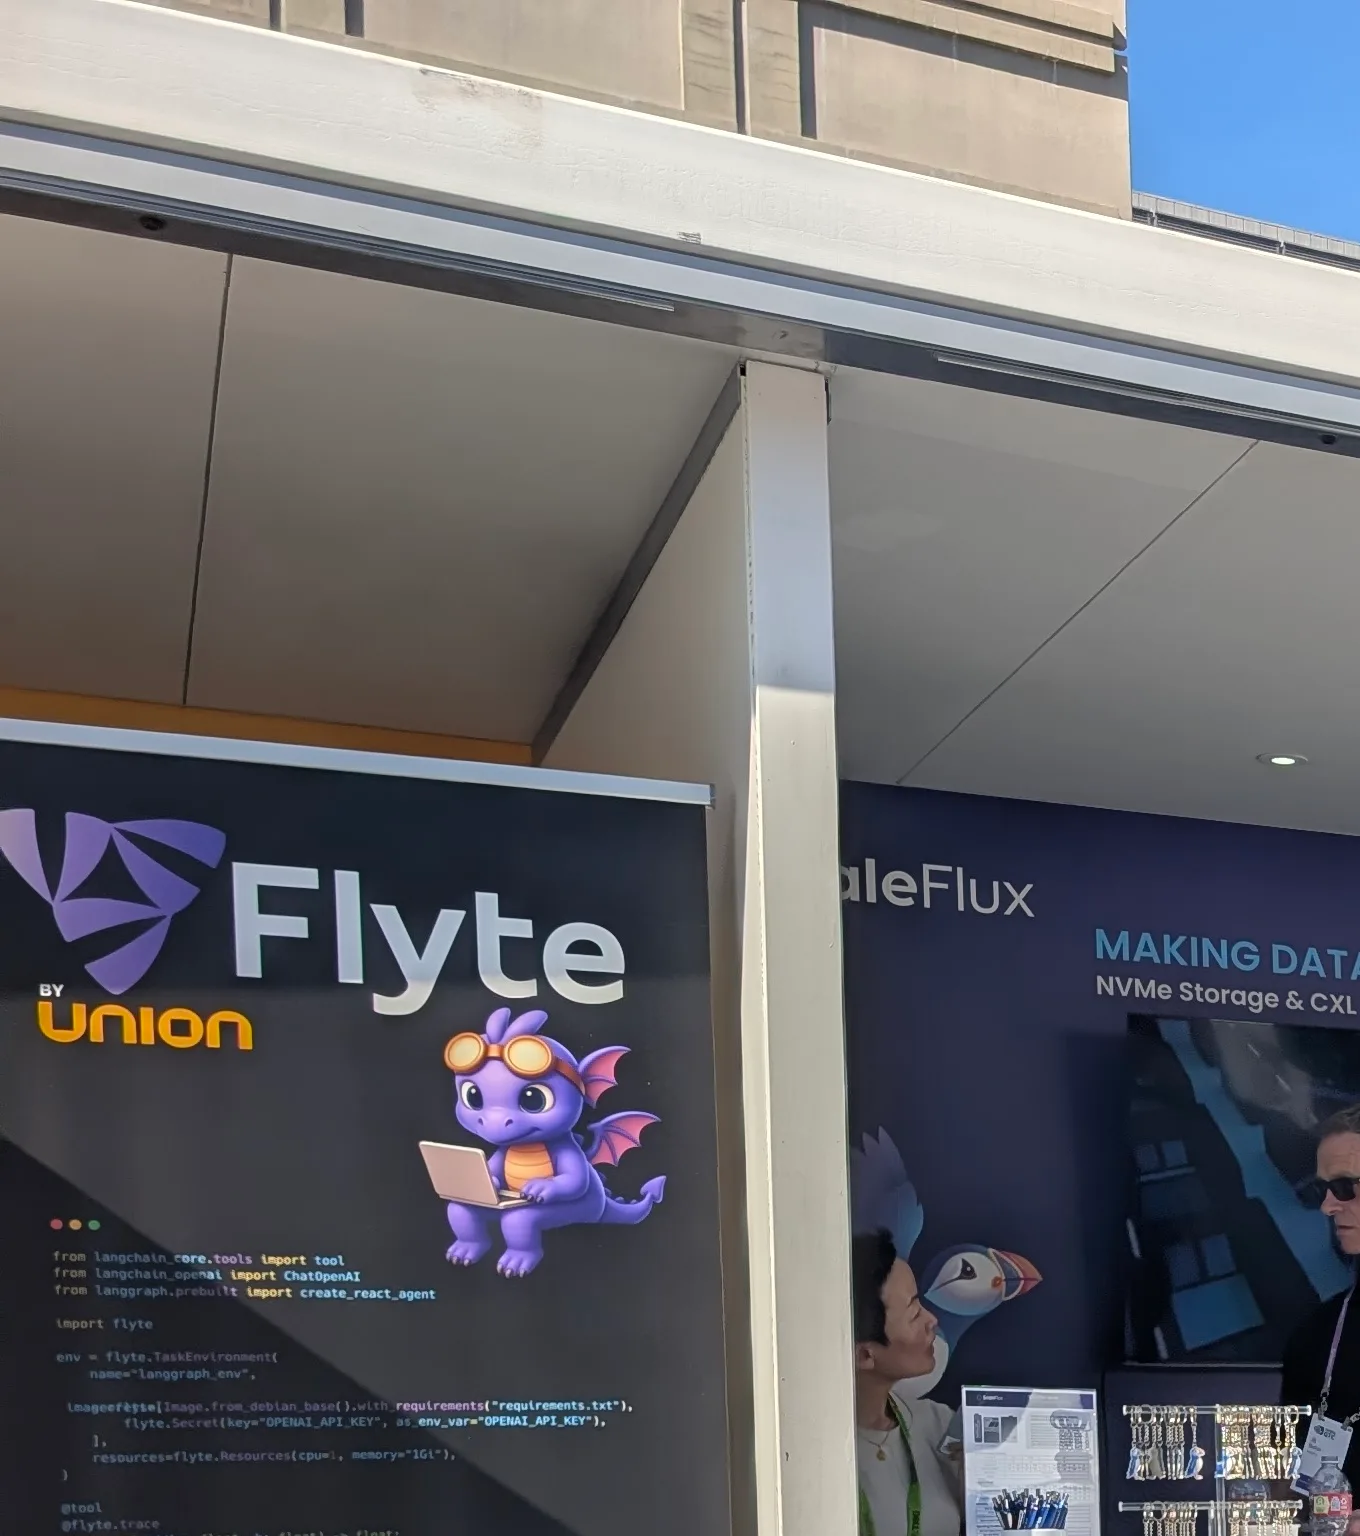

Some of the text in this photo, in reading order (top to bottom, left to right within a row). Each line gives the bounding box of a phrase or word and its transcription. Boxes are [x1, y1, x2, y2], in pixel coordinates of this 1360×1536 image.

[840, 858, 1034, 917] aleFlux
[231, 861, 626, 1015] Flyte
[1094, 927, 1260, 972] MAKING
[39, 983, 64, 997] BY
[1095, 974, 1173, 1001] NVMe
[1179, 981, 1281, 1014] Storage
[1286, 991, 1304, 1010] &
[1310, 993, 1357, 1016] CXL
[53, 1250, 345, 1267] from langchain_core.tools import tool
[54, 1266, 361, 1284] from langchain_openai import ChatOpenAI
[55, 1284, 436, 1302] from langgraph.prebuilt import create_react_agent
[56, 1317, 154, 1332] import flyte
[56, 1353, 81, 1363] env
[60, 1501, 103, 1516] @tool
